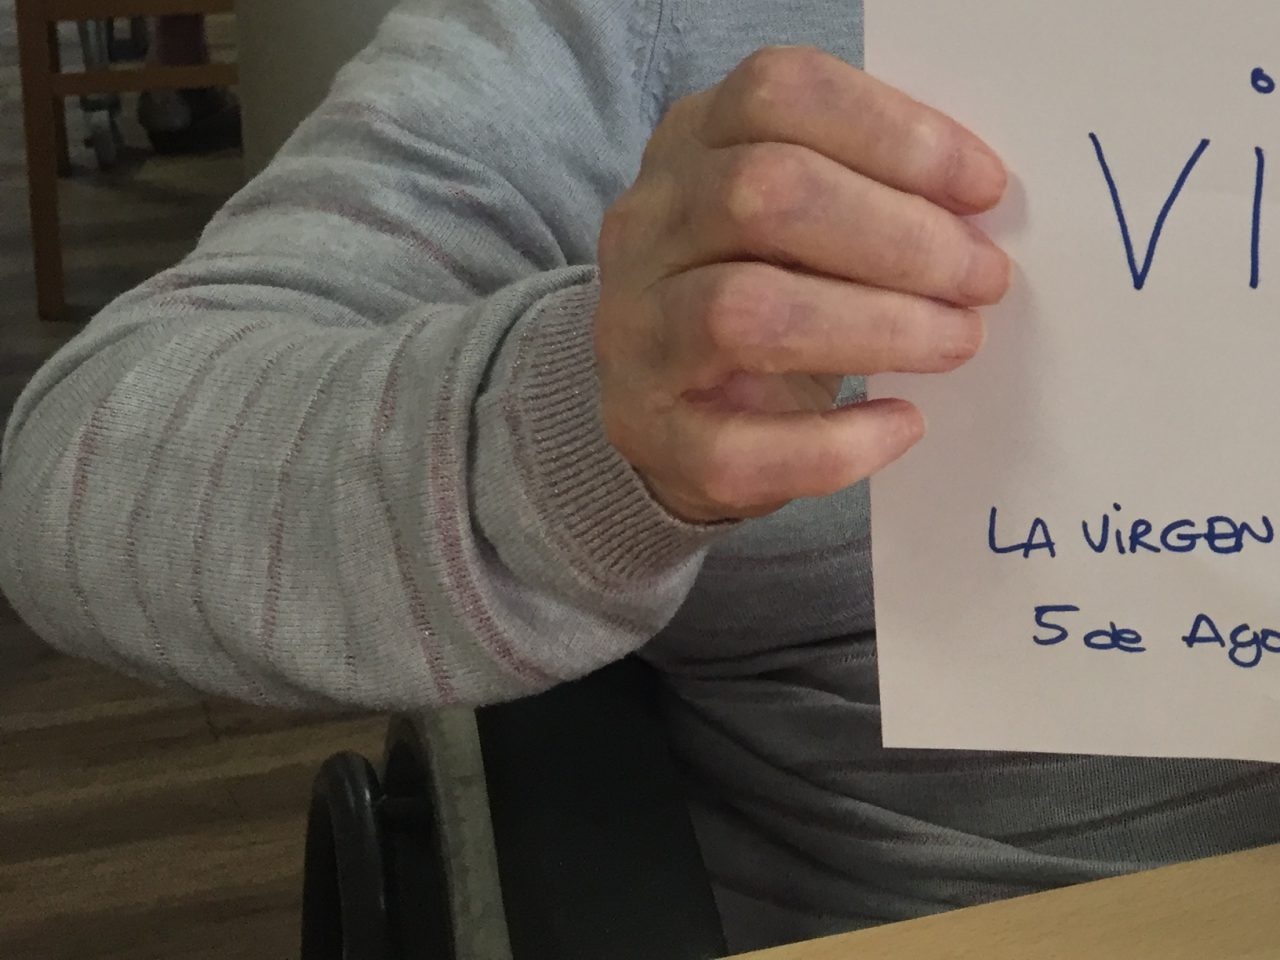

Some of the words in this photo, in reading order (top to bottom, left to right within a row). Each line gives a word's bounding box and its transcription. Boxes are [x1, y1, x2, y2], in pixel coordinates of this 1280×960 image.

[988, 506, 1056, 559] LA
[1032, 604, 1081, 647] 5
[1083, 620, 1147, 653] de
